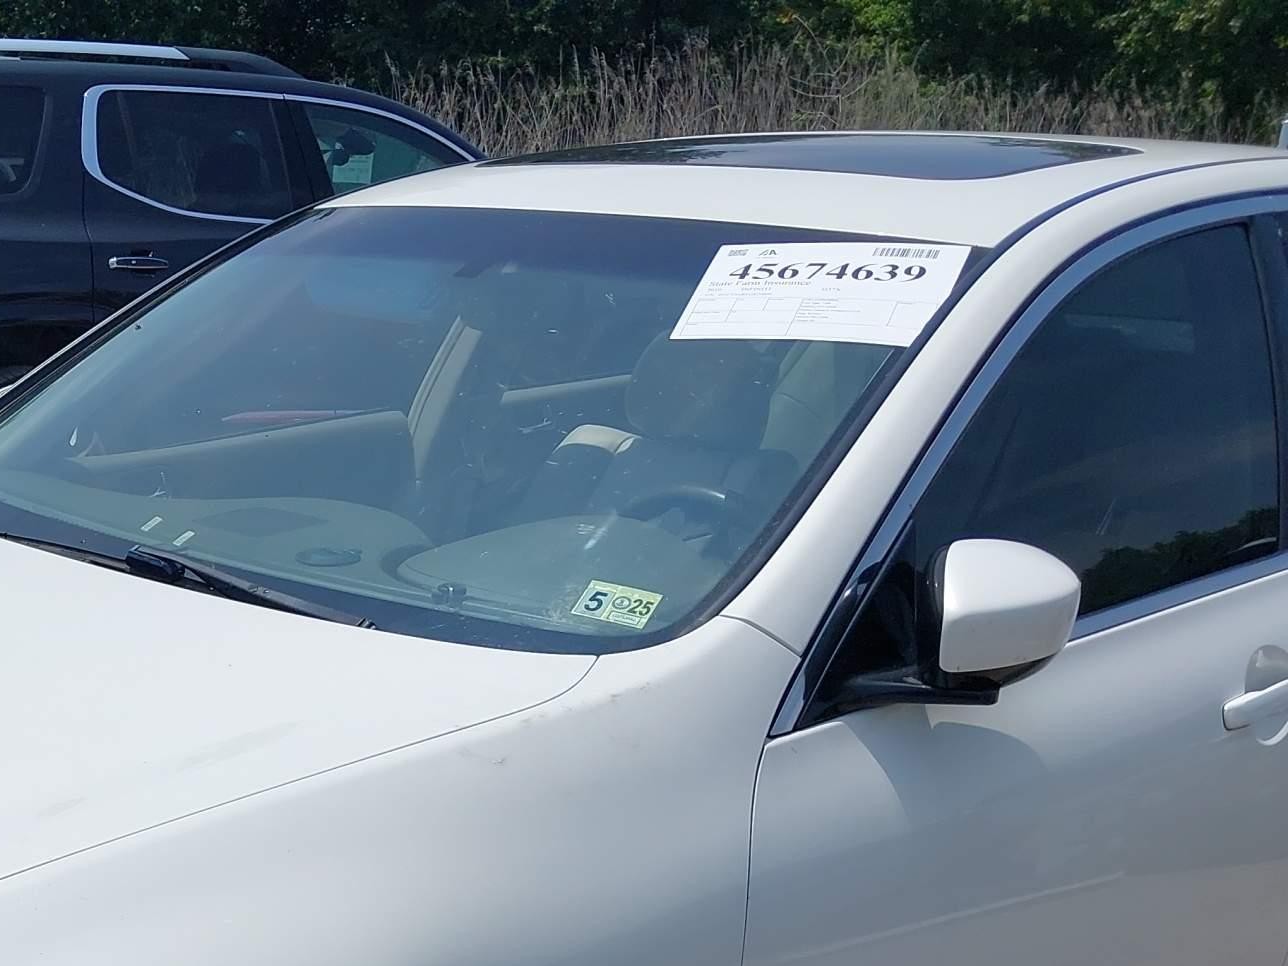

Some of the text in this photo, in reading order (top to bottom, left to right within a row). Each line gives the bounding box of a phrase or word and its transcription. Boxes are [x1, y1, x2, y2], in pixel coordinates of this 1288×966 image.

[729, 262, 926, 282] 45674639
[764, 279, 812, 287] Insurance
[584, 591, 654, 616] 5 25
